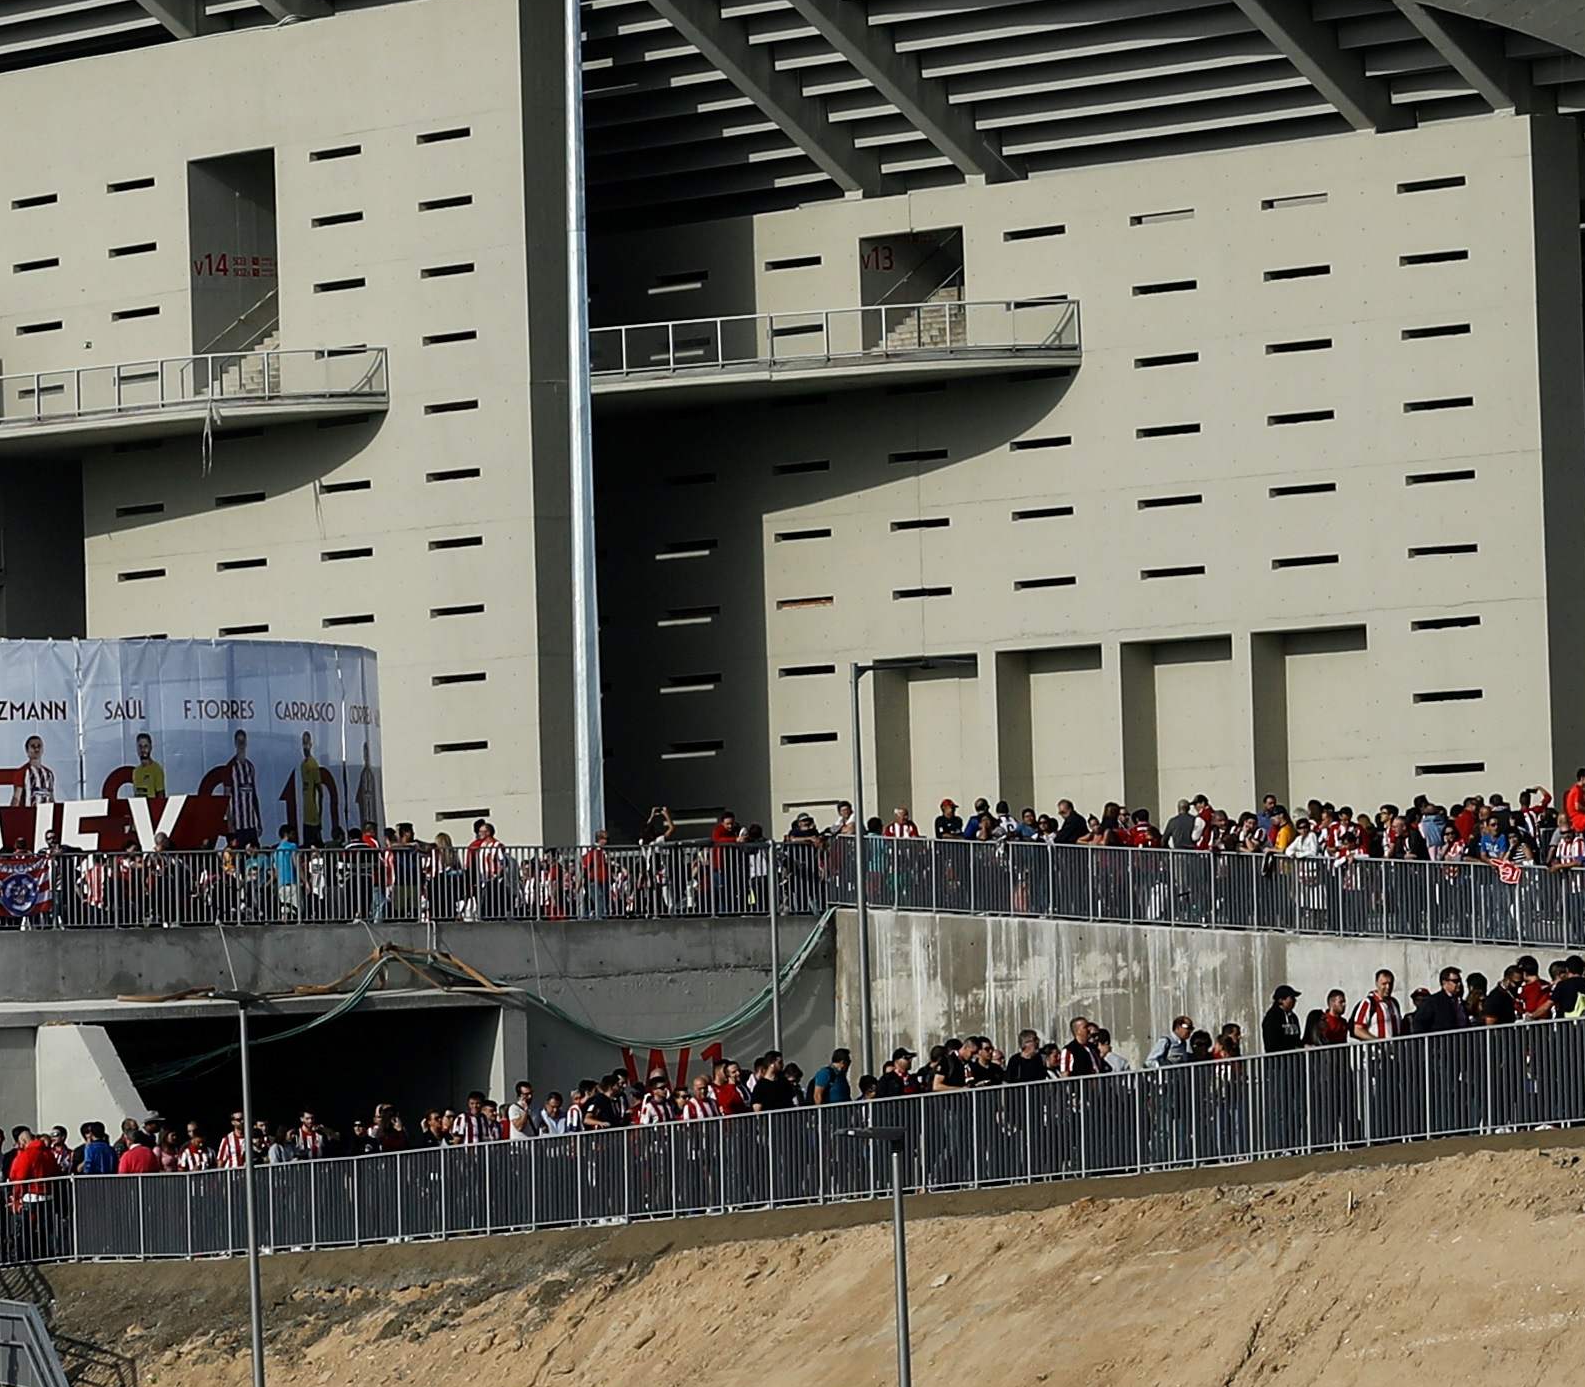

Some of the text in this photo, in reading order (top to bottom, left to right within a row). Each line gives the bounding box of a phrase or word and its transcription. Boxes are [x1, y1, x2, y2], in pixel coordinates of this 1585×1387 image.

[195, 253, 229, 277] v14
[862, 246, 894, 272] v13
[104, 697, 146, 720] SAÚL
[275, 701, 335, 722] CARRASCO
